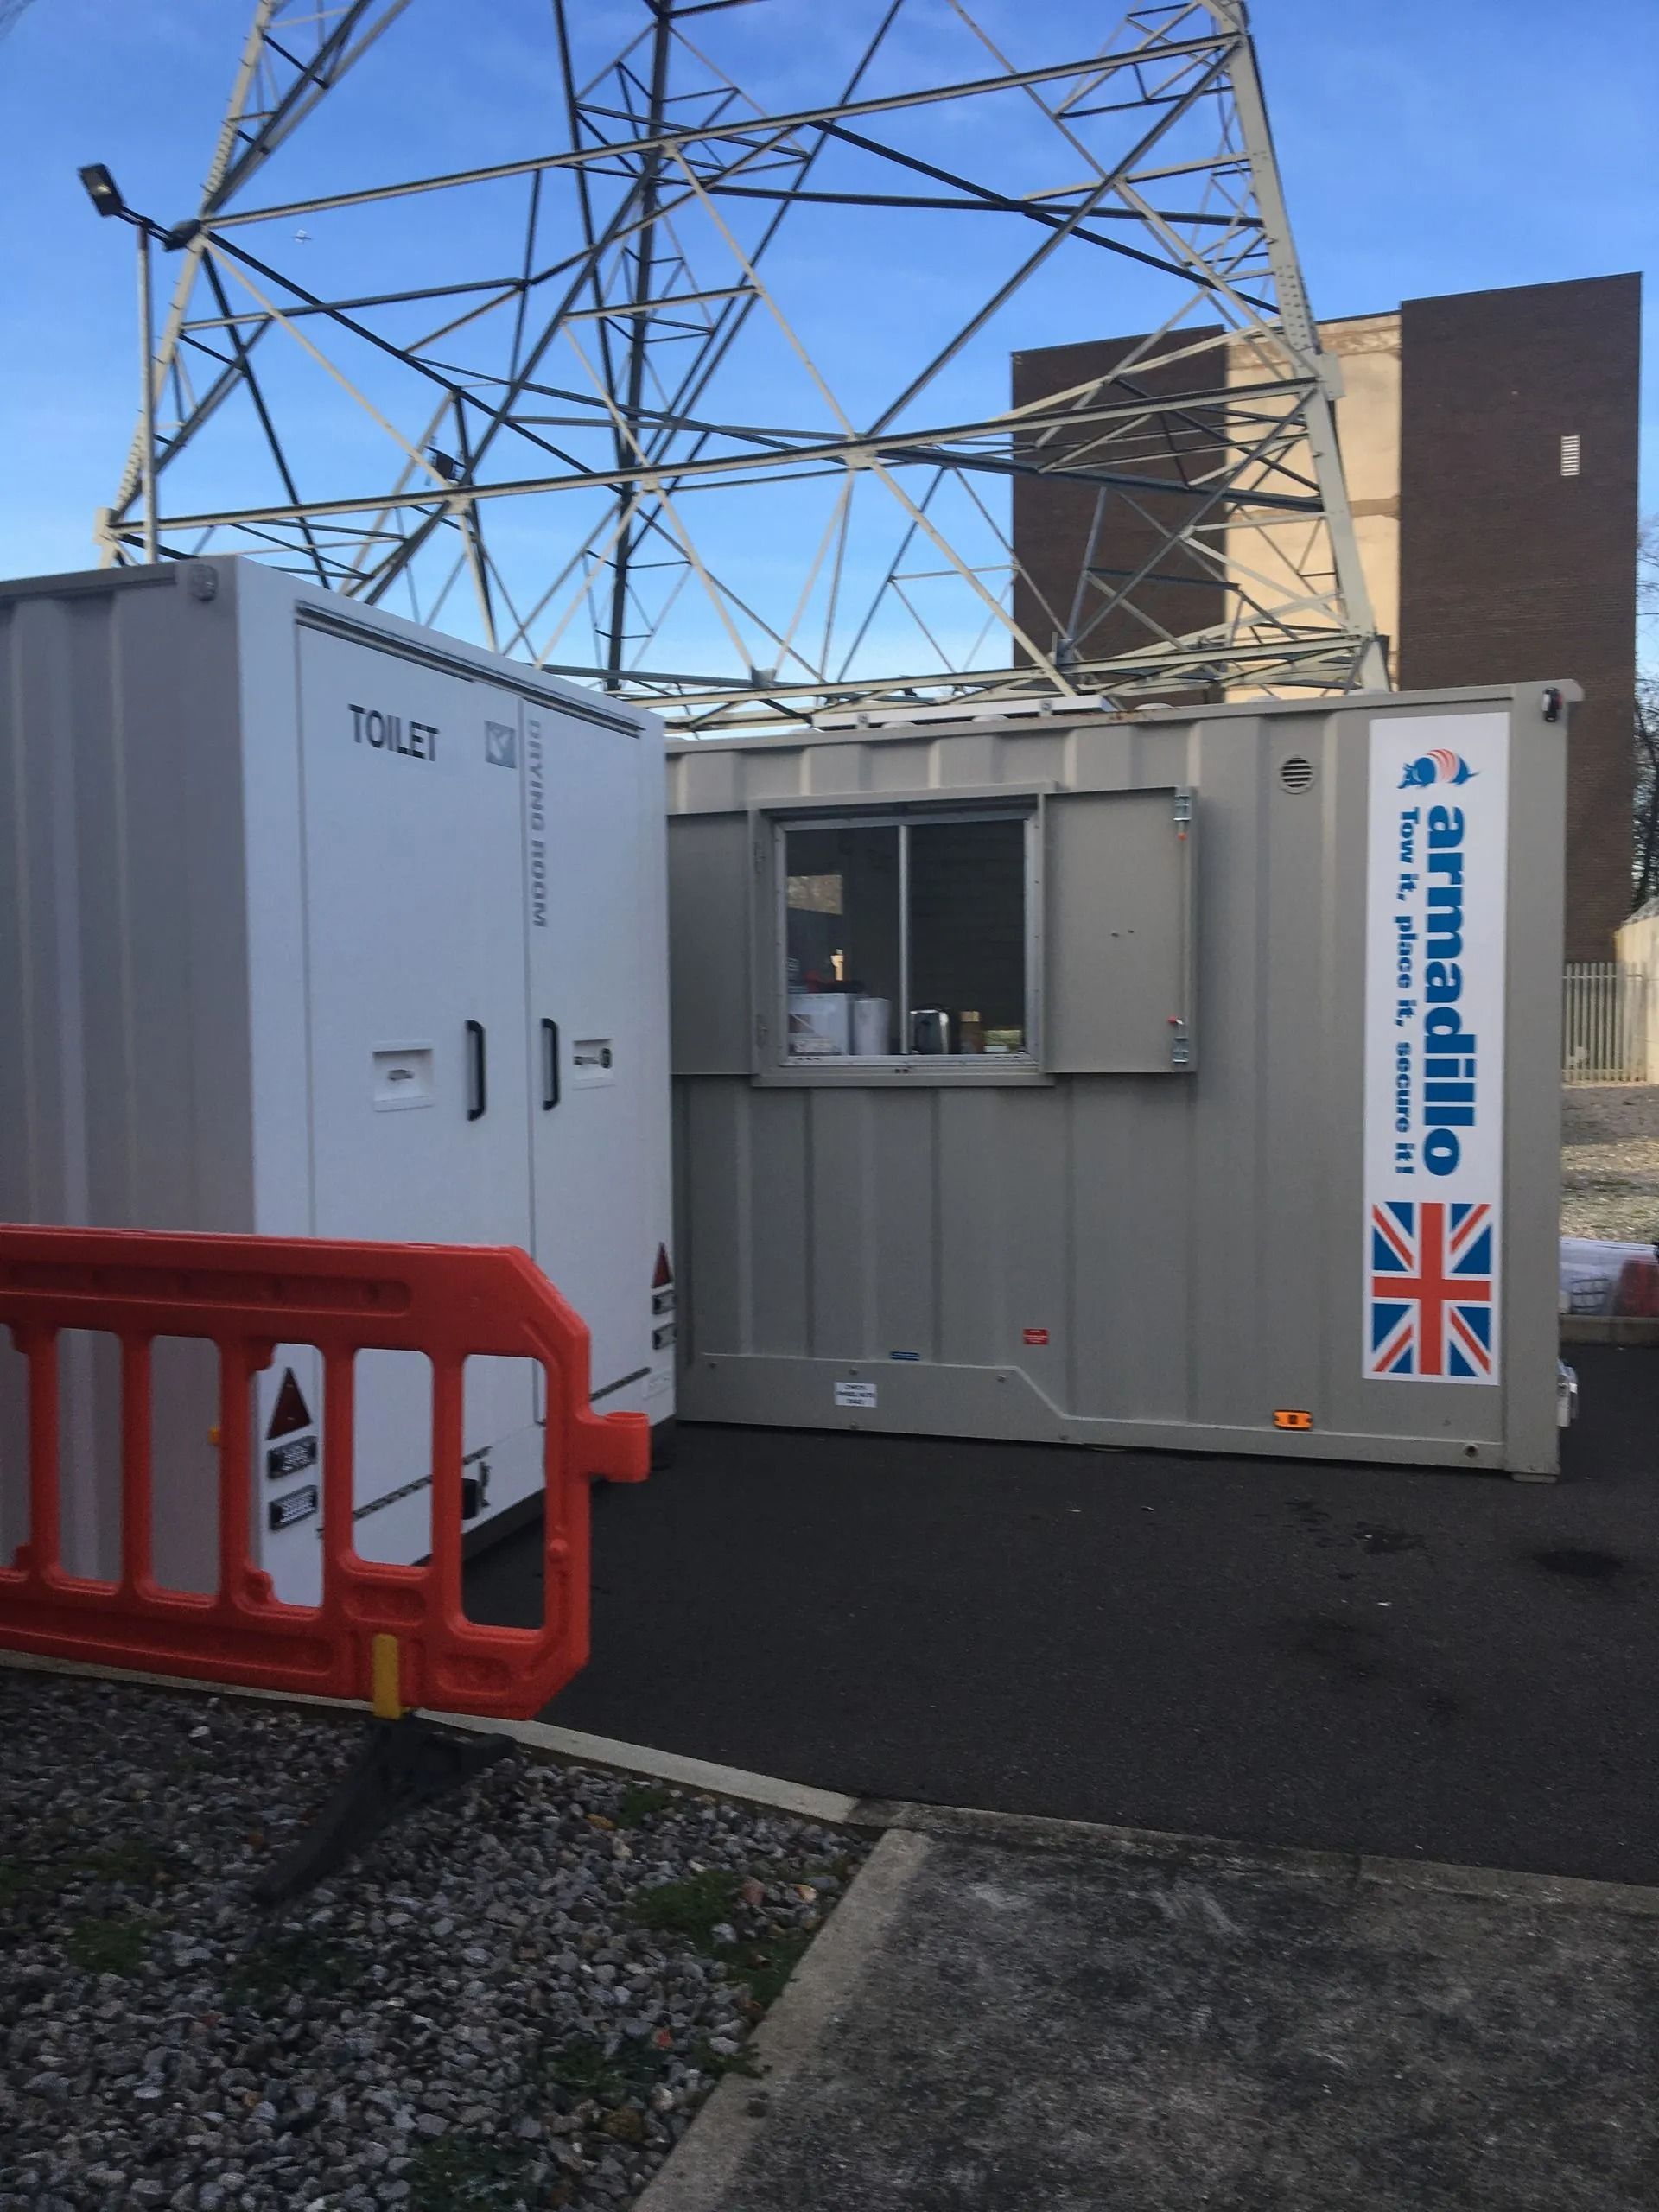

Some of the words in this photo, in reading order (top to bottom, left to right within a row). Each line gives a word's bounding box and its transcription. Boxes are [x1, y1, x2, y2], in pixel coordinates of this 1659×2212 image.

[348, 703, 440, 761] TOILET
[529, 719, 545, 831] DRYING
[1400, 806, 1420, 863] Tow
[531, 839, 547, 927] ROOM
[1396, 873, 1419, 901] it,
[1394, 915, 1418, 988] place
[1395, 999, 1417, 1027] it,
[1423, 804, 1476, 1176] armadillo
[1395, 1042, 1411, 1133] secure
